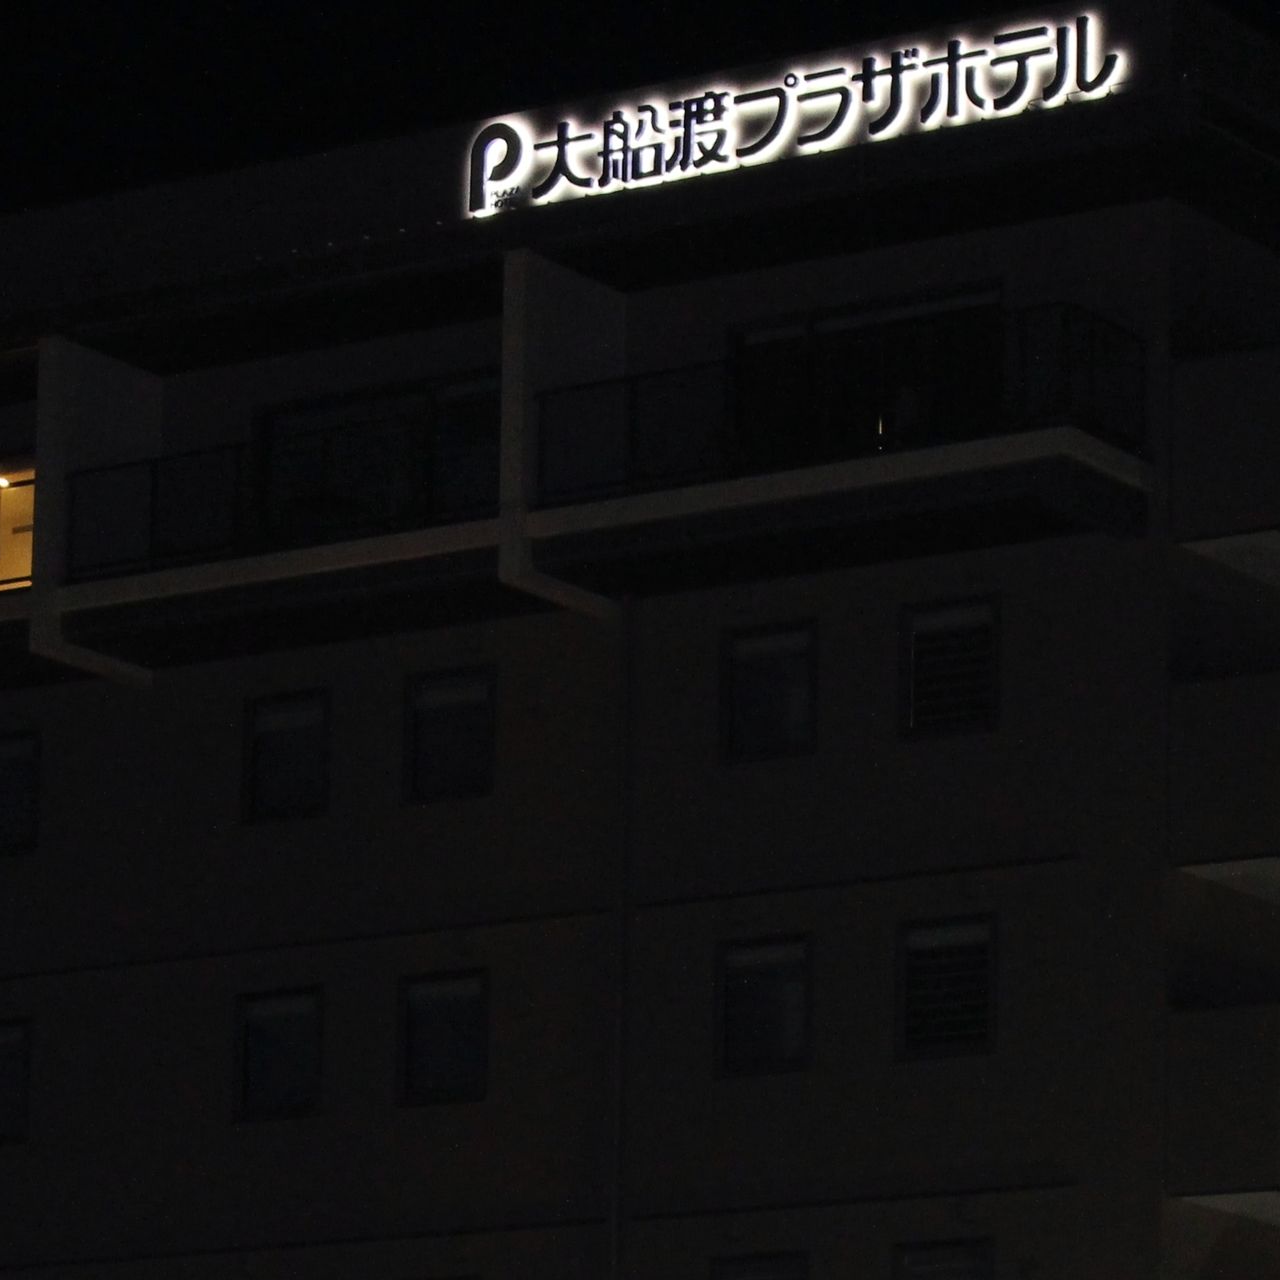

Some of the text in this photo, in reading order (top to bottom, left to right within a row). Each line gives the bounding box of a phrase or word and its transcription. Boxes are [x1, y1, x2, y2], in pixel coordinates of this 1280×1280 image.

[532, 16, 1118, 200] 大船渡プラザホテル
